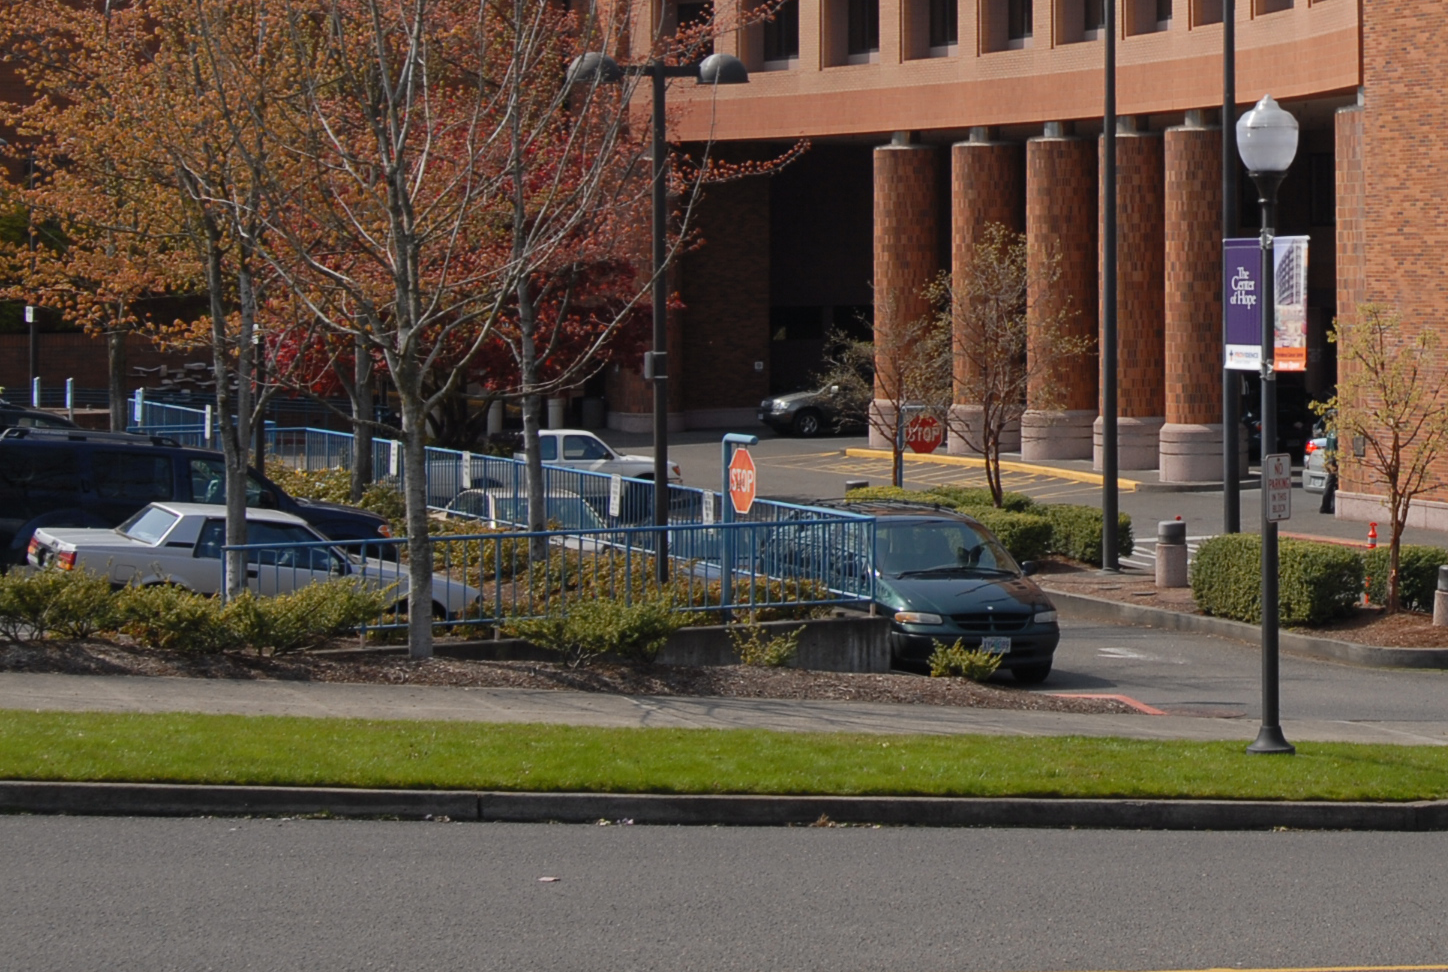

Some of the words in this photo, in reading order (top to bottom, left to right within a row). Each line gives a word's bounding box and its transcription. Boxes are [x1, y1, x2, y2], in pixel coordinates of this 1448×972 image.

[1237, 266, 1250, 279] The
[1231, 275, 1255, 291] Center
[1230, 291, 1238, 305] of
[1237, 290, 1257, 309] Hope
[909, 426, 939, 443] STOP
[1274, 463, 1284, 475] NO
[731, 468, 754, 493] STOP
